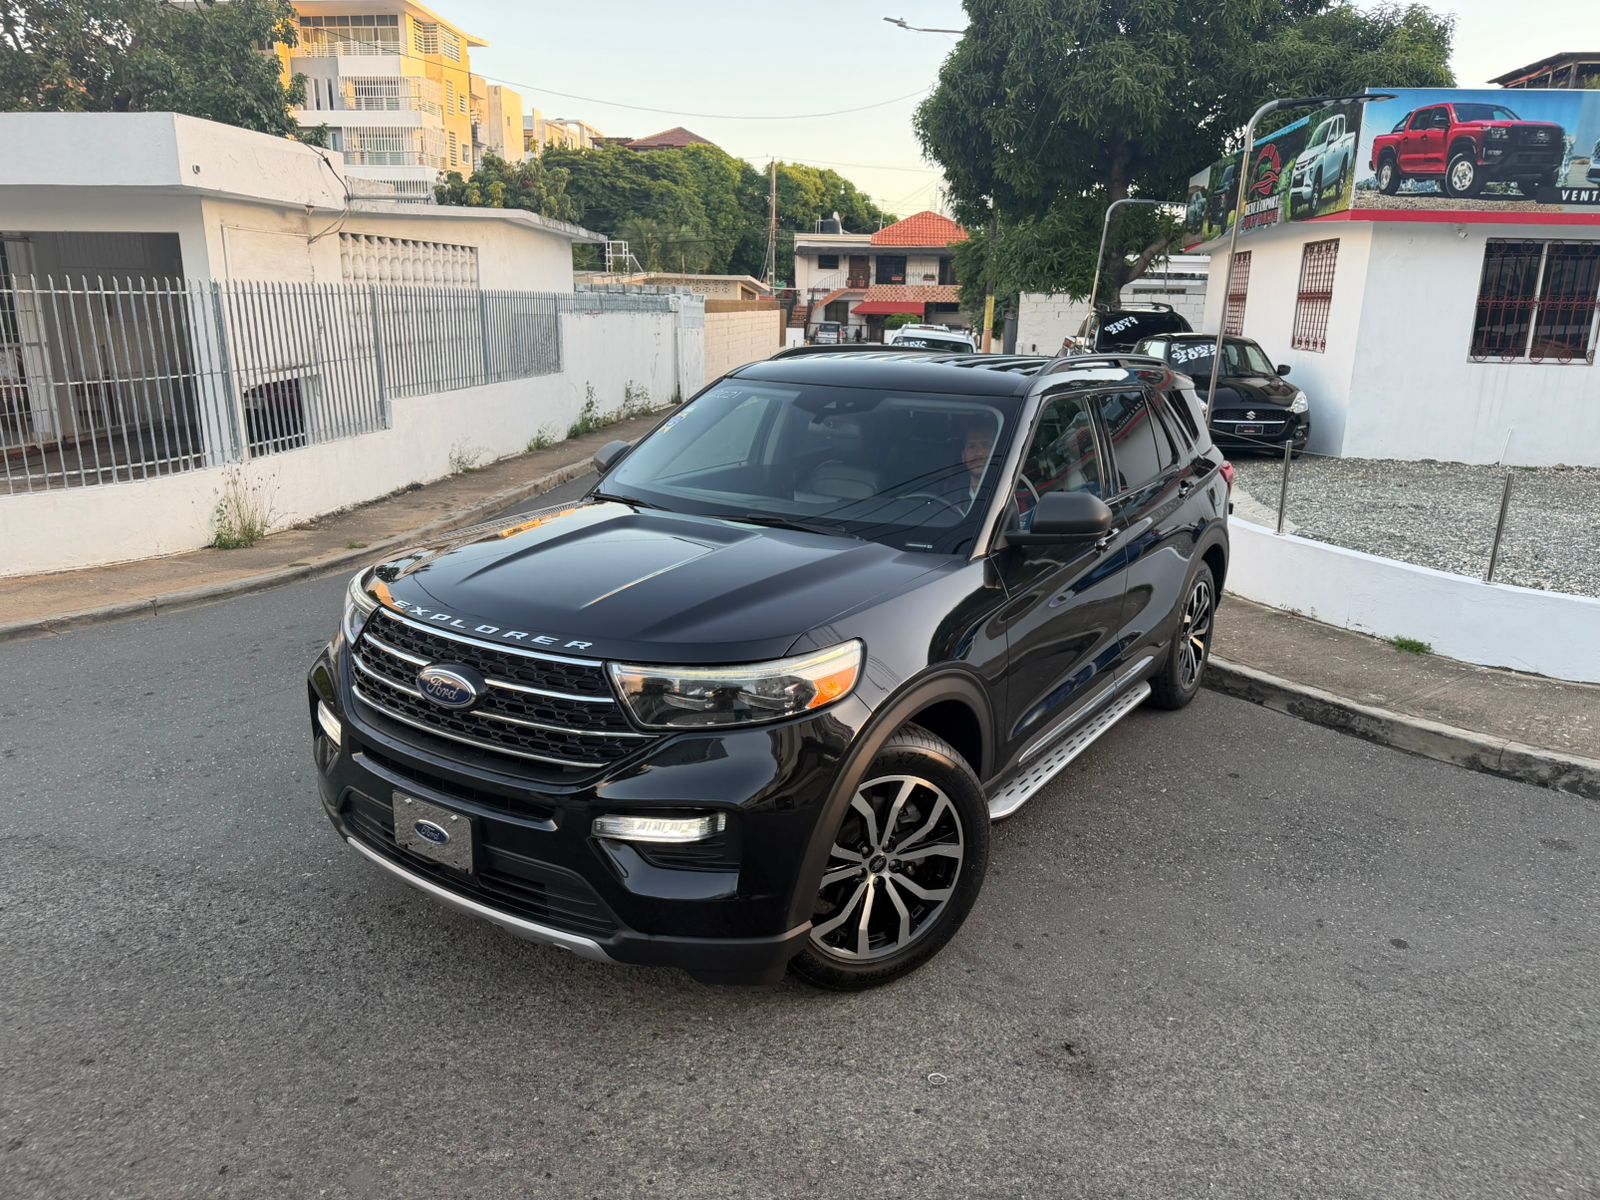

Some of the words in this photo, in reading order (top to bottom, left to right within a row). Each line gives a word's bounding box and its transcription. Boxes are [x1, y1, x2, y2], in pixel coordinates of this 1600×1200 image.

[1561, 189, 1600, 202] VENT
[393, 600, 593, 650] EXPLORER
[427, 676, 459, 700] Ford
[420, 824, 441, 841] Ford
